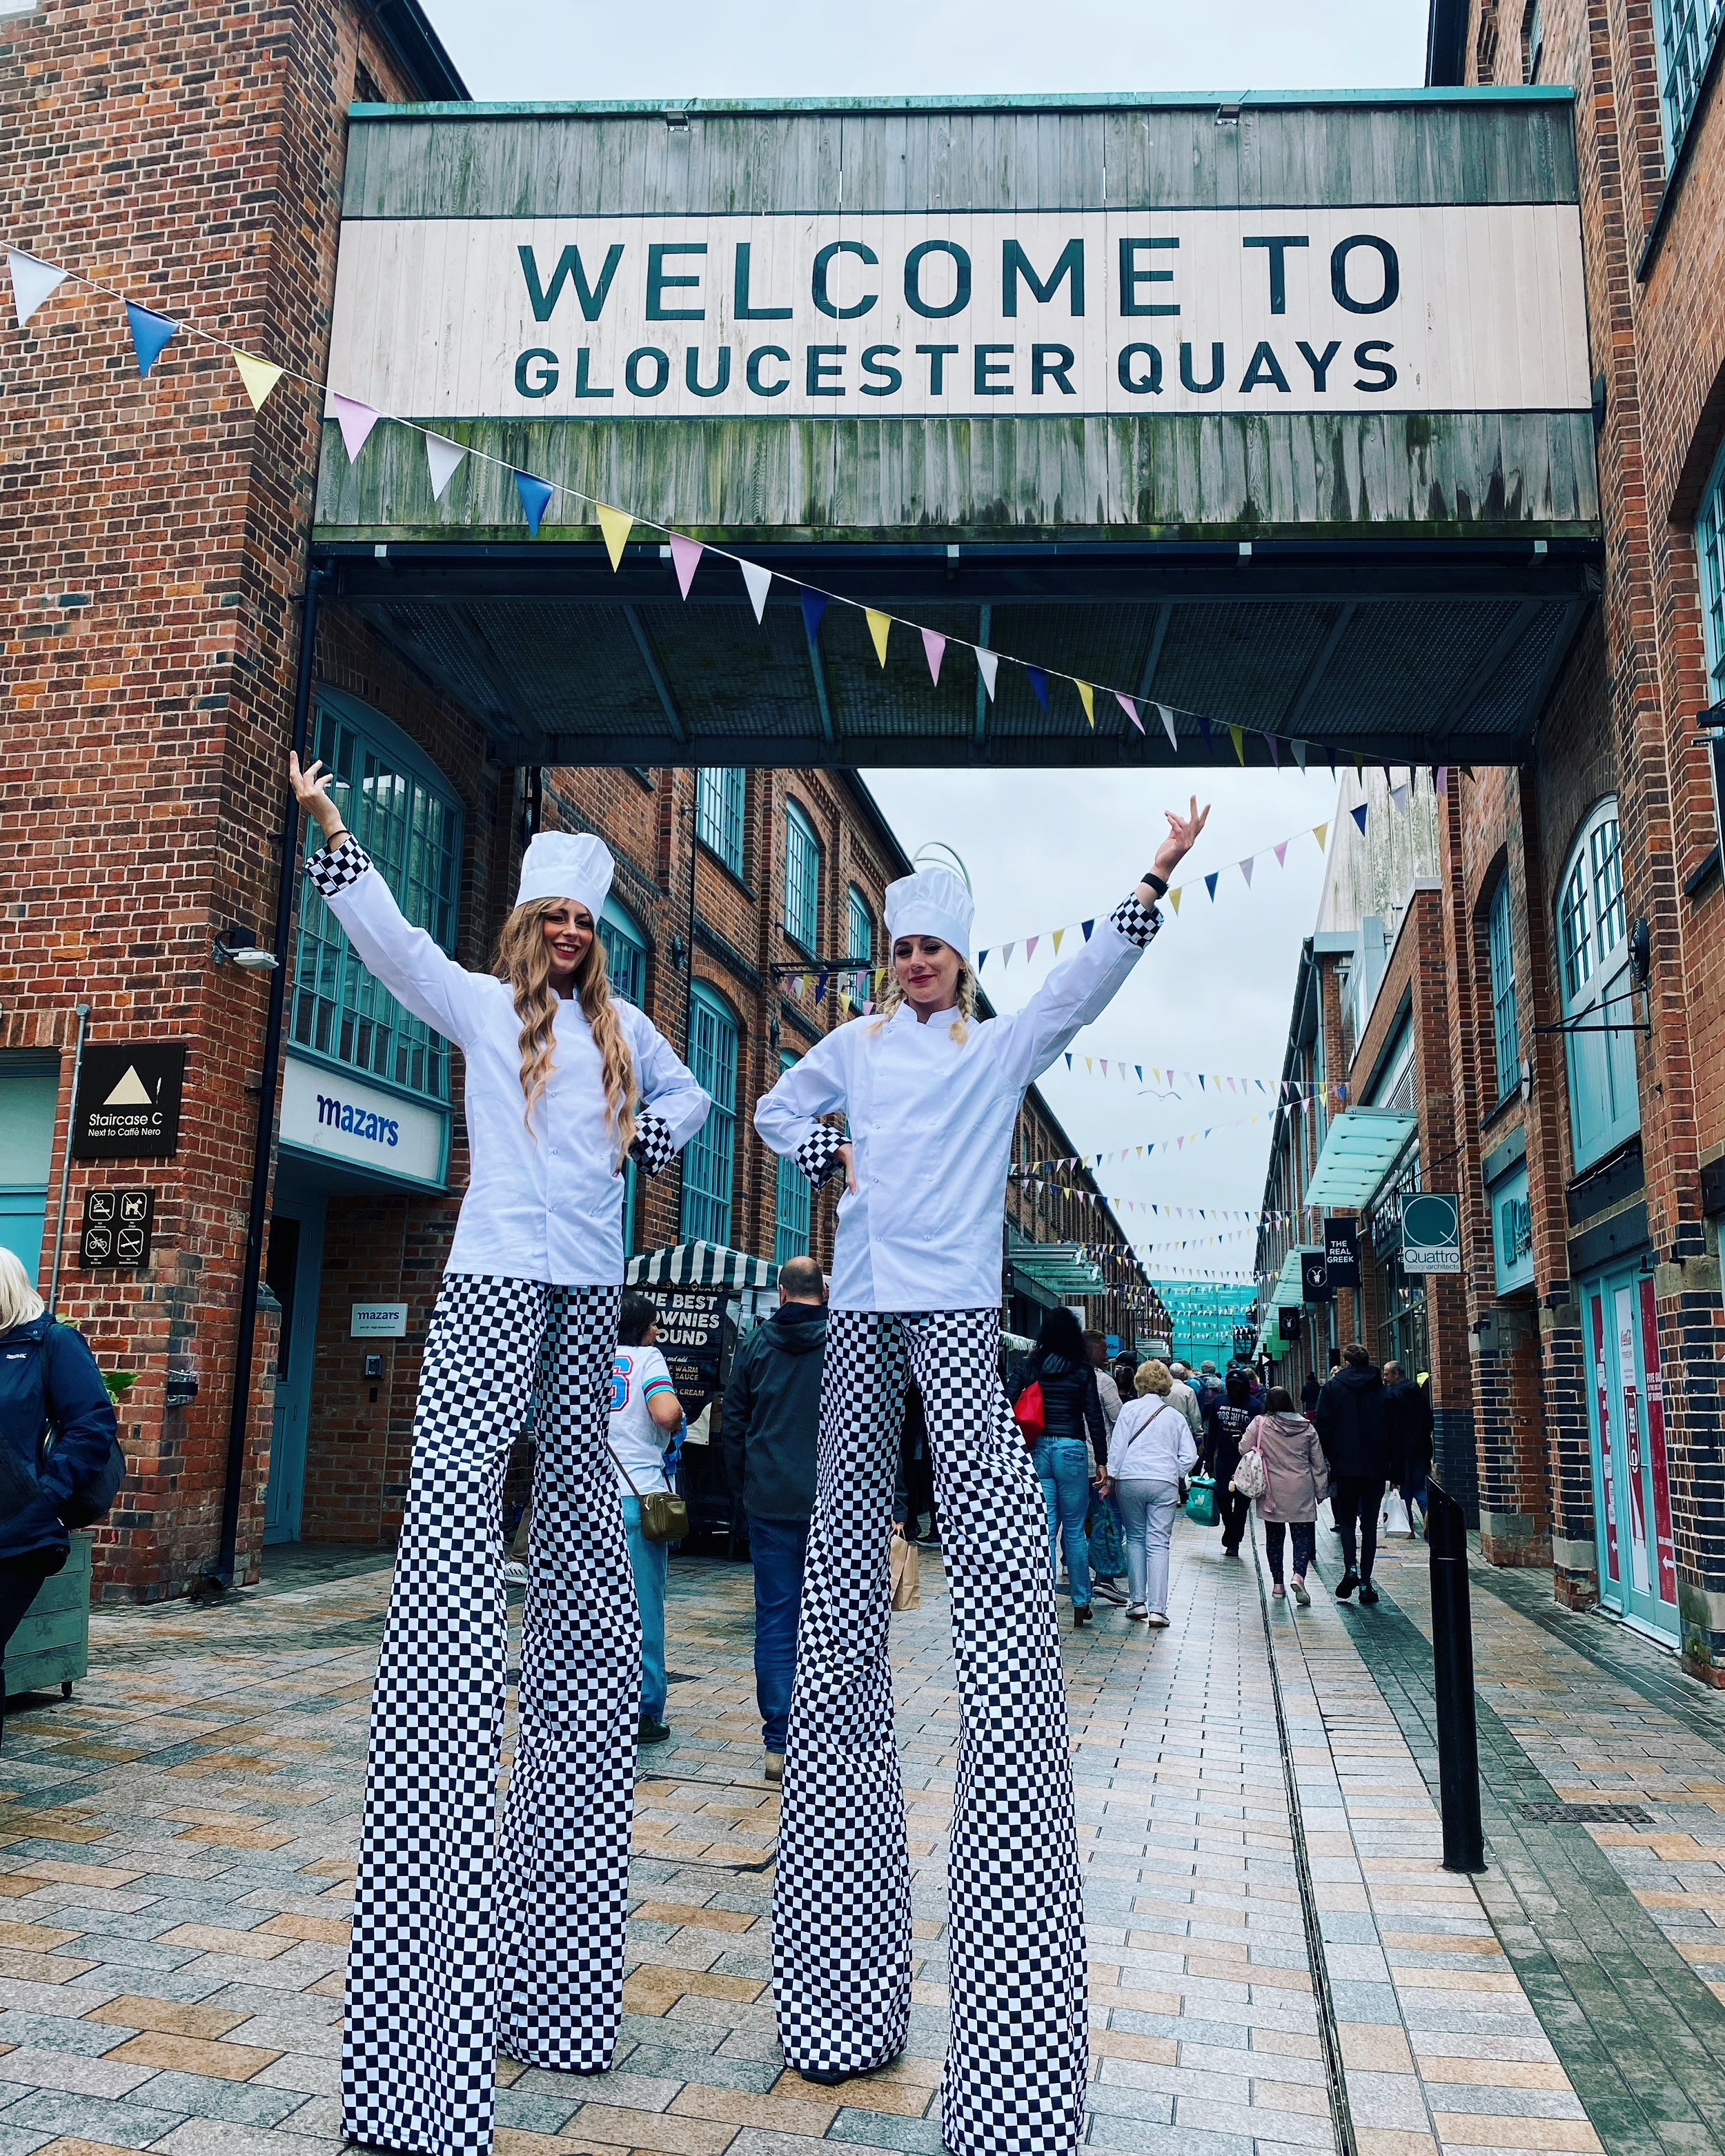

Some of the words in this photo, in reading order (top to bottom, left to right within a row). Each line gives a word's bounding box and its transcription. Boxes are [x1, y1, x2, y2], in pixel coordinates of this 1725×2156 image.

[517, 237, 1181, 322] WELCOME
[1243, 234, 1400, 315] TO
[514, 342, 1076, 398] GLOUCESTER
[1117, 339, 1399, 395] QUAYS
[89, 1114, 148, 1126] Staircase
[152, 1112, 164, 1125] C
[317, 1094, 399, 1146] mazars
[108, 1128, 116, 1136] to
[117, 1127, 139, 1136] Caffè
[1405, 1249, 1459, 1263] Quattro
[672, 1294, 718, 1310] BEST
[656, 1310, 720, 1329] WNIES
[656, 1328, 707, 1345] OUND
[680, 1388, 704, 1396] CREAM
